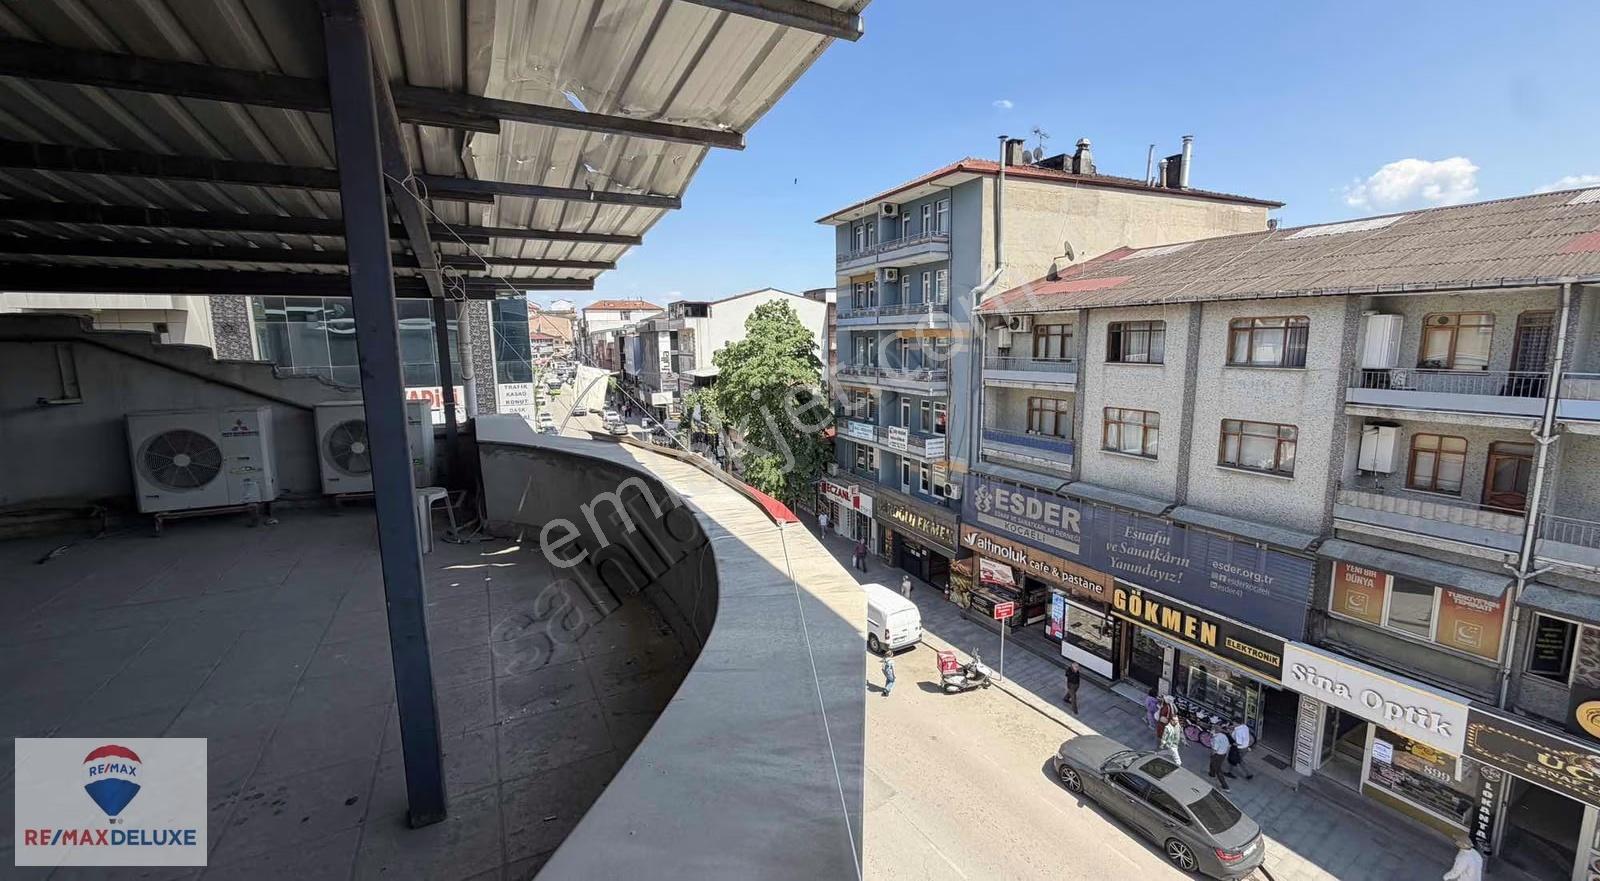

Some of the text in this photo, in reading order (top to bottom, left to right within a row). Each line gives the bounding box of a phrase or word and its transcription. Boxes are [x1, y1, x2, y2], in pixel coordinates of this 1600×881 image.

[995, 488, 1081, 534] ESDER
[1106, 542, 1118, 552] ve
[1124, 526, 1171, 546] Esnafın
[1029, 559, 1050, 573] cafe
[1052, 567, 1060, 578] &
[1061, 572, 1104, 594] pastane
[1109, 556, 1184, 584] Yanındayız!
[1211, 560, 1275, 585] esder.org.tr
[1113, 588, 1217, 648] GÖKMEN
[1291, 662, 1352, 700] Sina
[1360, 688, 1453, 738] Optik
